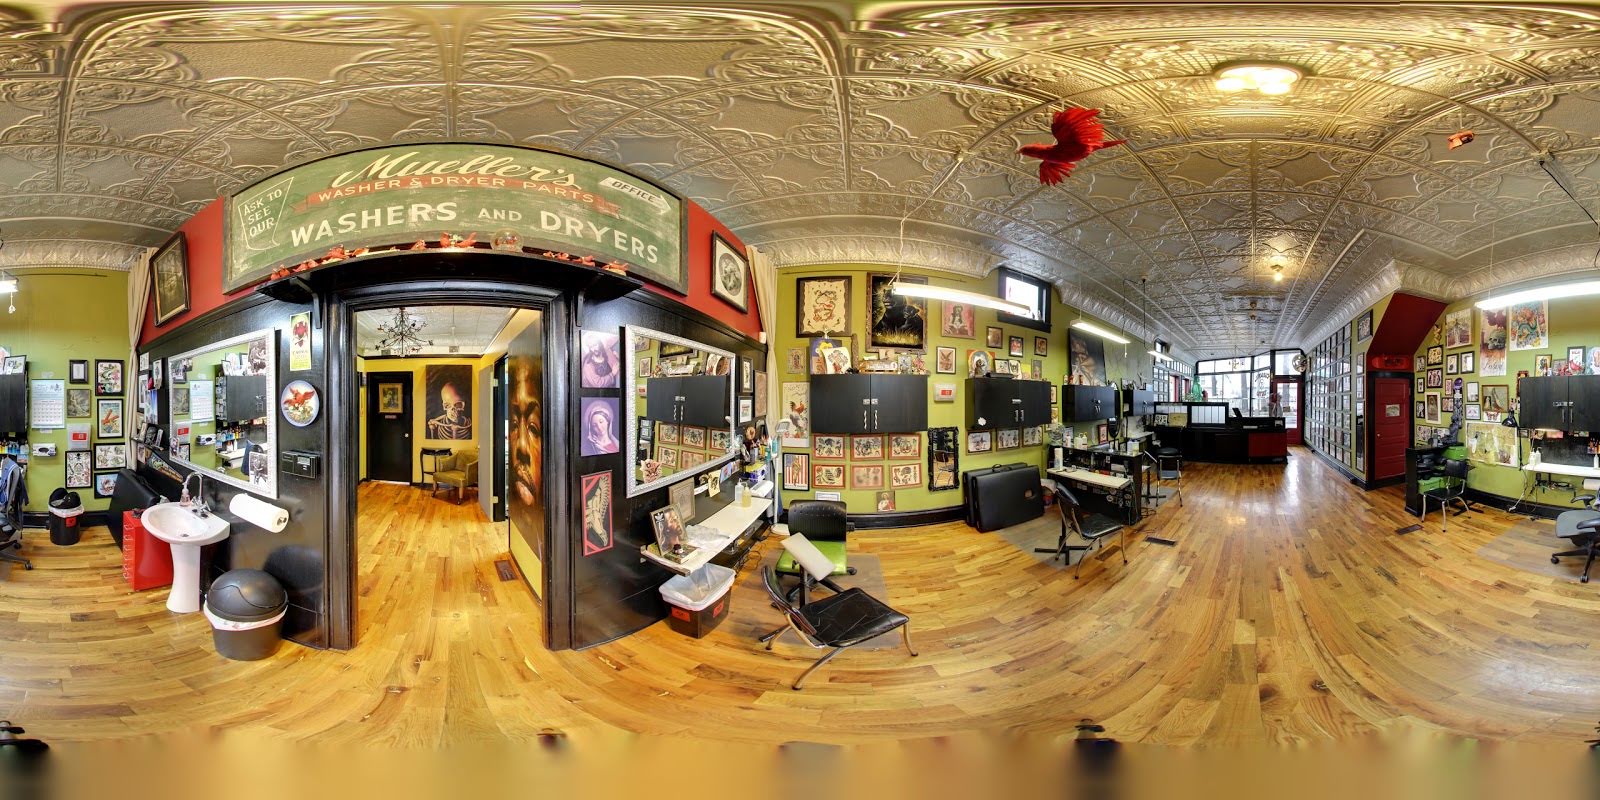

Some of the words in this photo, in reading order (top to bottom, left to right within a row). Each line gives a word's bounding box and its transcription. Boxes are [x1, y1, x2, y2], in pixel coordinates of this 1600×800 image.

[331, 151, 581, 190] Mueller's
[243, 198, 265, 217] ASK
[268, 188, 283, 202] TO
[318, 178, 401, 203] WASHER
[410, 177, 423, 187] &
[431, 176, 506, 187] DRYER
[523, 181, 594, 203] PARTS
[611, 180, 656, 203] OFFICE
[247, 205, 272, 225] SEE
[248, 217, 275, 238] OUR
[290, 201, 457, 248] WASHERS
[478, 207, 522, 222] AND
[540, 211, 658, 264] DRYERS
